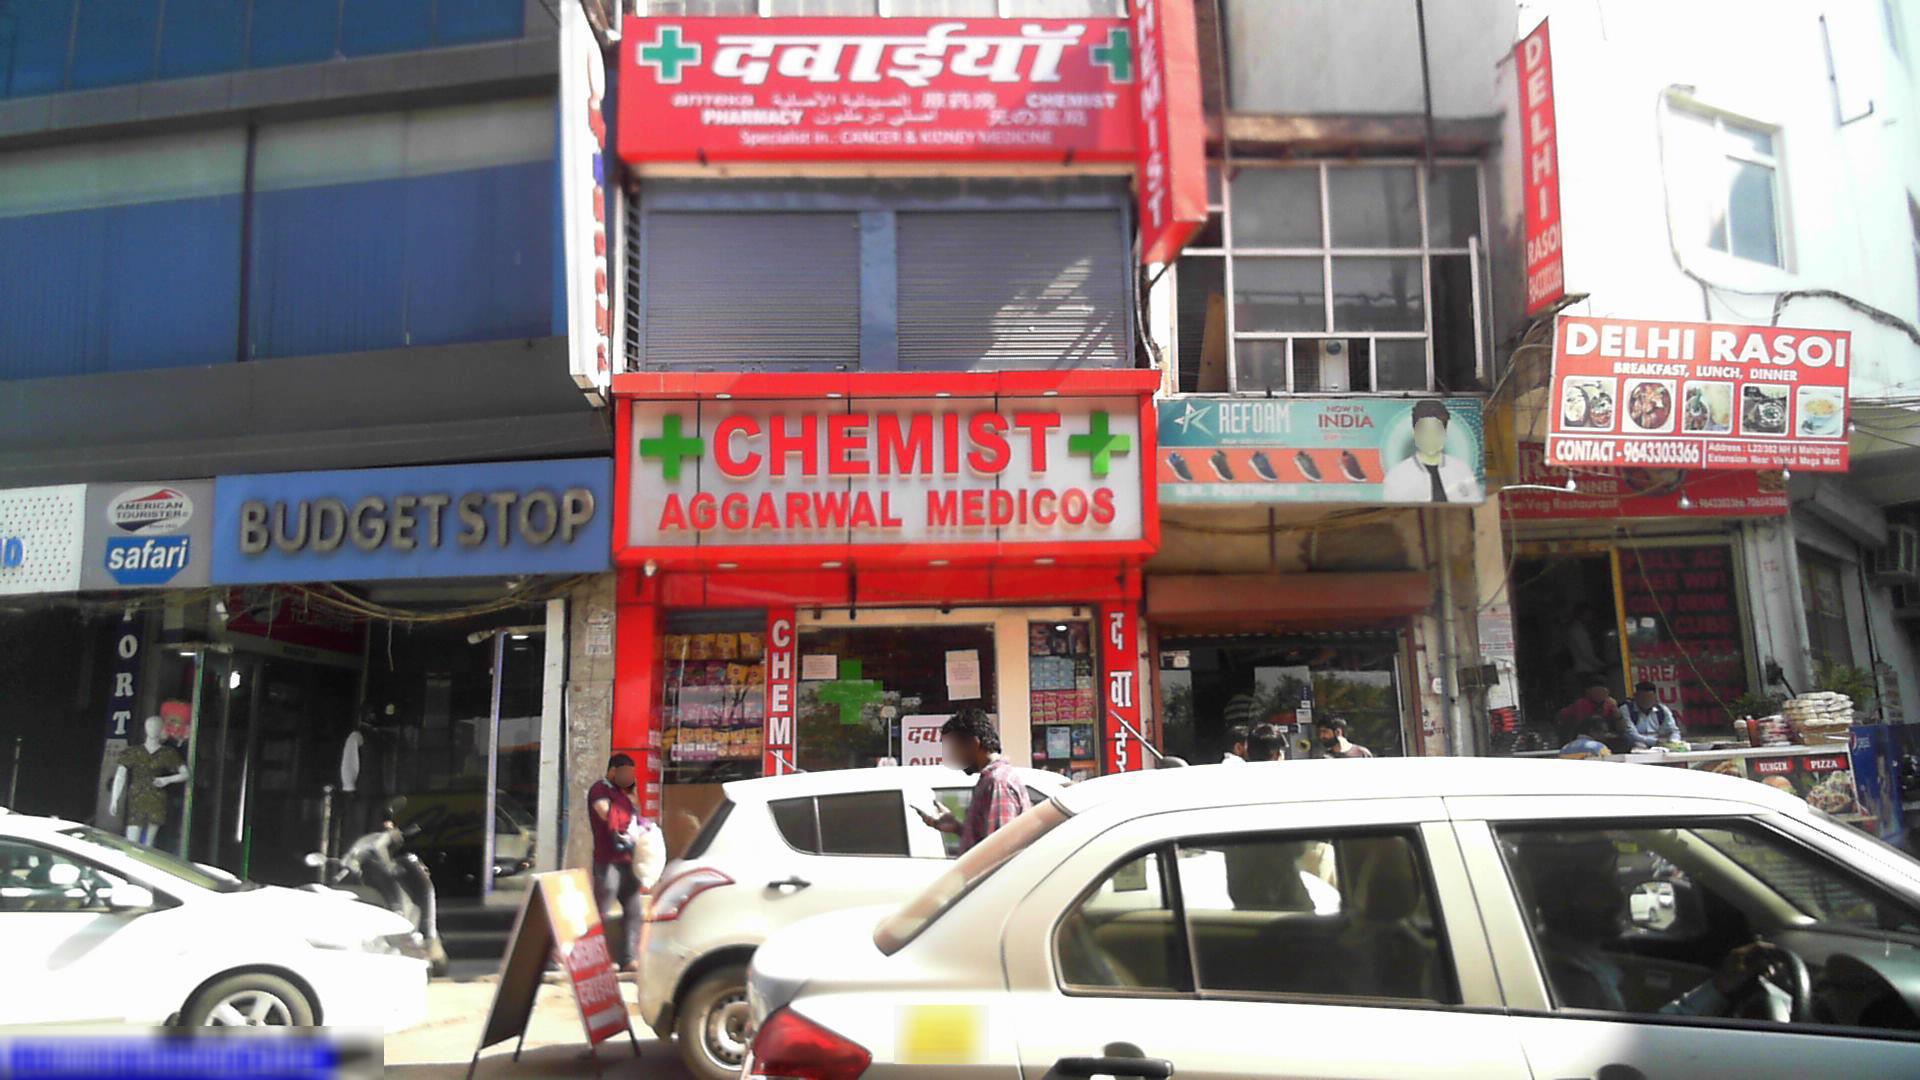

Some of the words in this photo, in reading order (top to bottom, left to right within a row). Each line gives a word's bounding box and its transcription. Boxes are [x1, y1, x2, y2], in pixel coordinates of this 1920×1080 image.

[1026, 93, 1116, 109] CHEMIST
[703, 110, 803, 125] PHARMACY
[1136, 0, 1164, 228] HEMIST
[1524, 34, 1552, 219] DELHI
[841, 131, 899, 144] CANCER
[1565, 322, 1696, 361] DELHI
[1711, 331, 1846, 368] RASOI
[1613, 361, 1690, 378] BREAKFAST,
[1696, 365, 1743, 380] LUNCH,
[1750, 368, 1798, 381] DINNER
[1318, 414, 1376, 429] INDIA
[712, 411, 1061, 478] CHEMIST
[1556, 440, 1615, 462] CONTACT
[1623, 442, 1699, 465] 9643303366
[1708, 453, 1748, 463] Extension
[116, 501, 184, 511] AMERICAN
[116, 510, 180, 519] TOURISTER
[659, 491, 902, 532] AGGARWAL
[927, 487, 1115, 528] MEDICOS
[240, 495, 450, 555] BUDGET
[458, 487, 595, 546] STOP
[0, 535, 24, 569] D
[108, 538, 190, 570] safari
[768, 619, 791, 776] CHEMI
[1810, 759, 1838, 770] PIZZA
